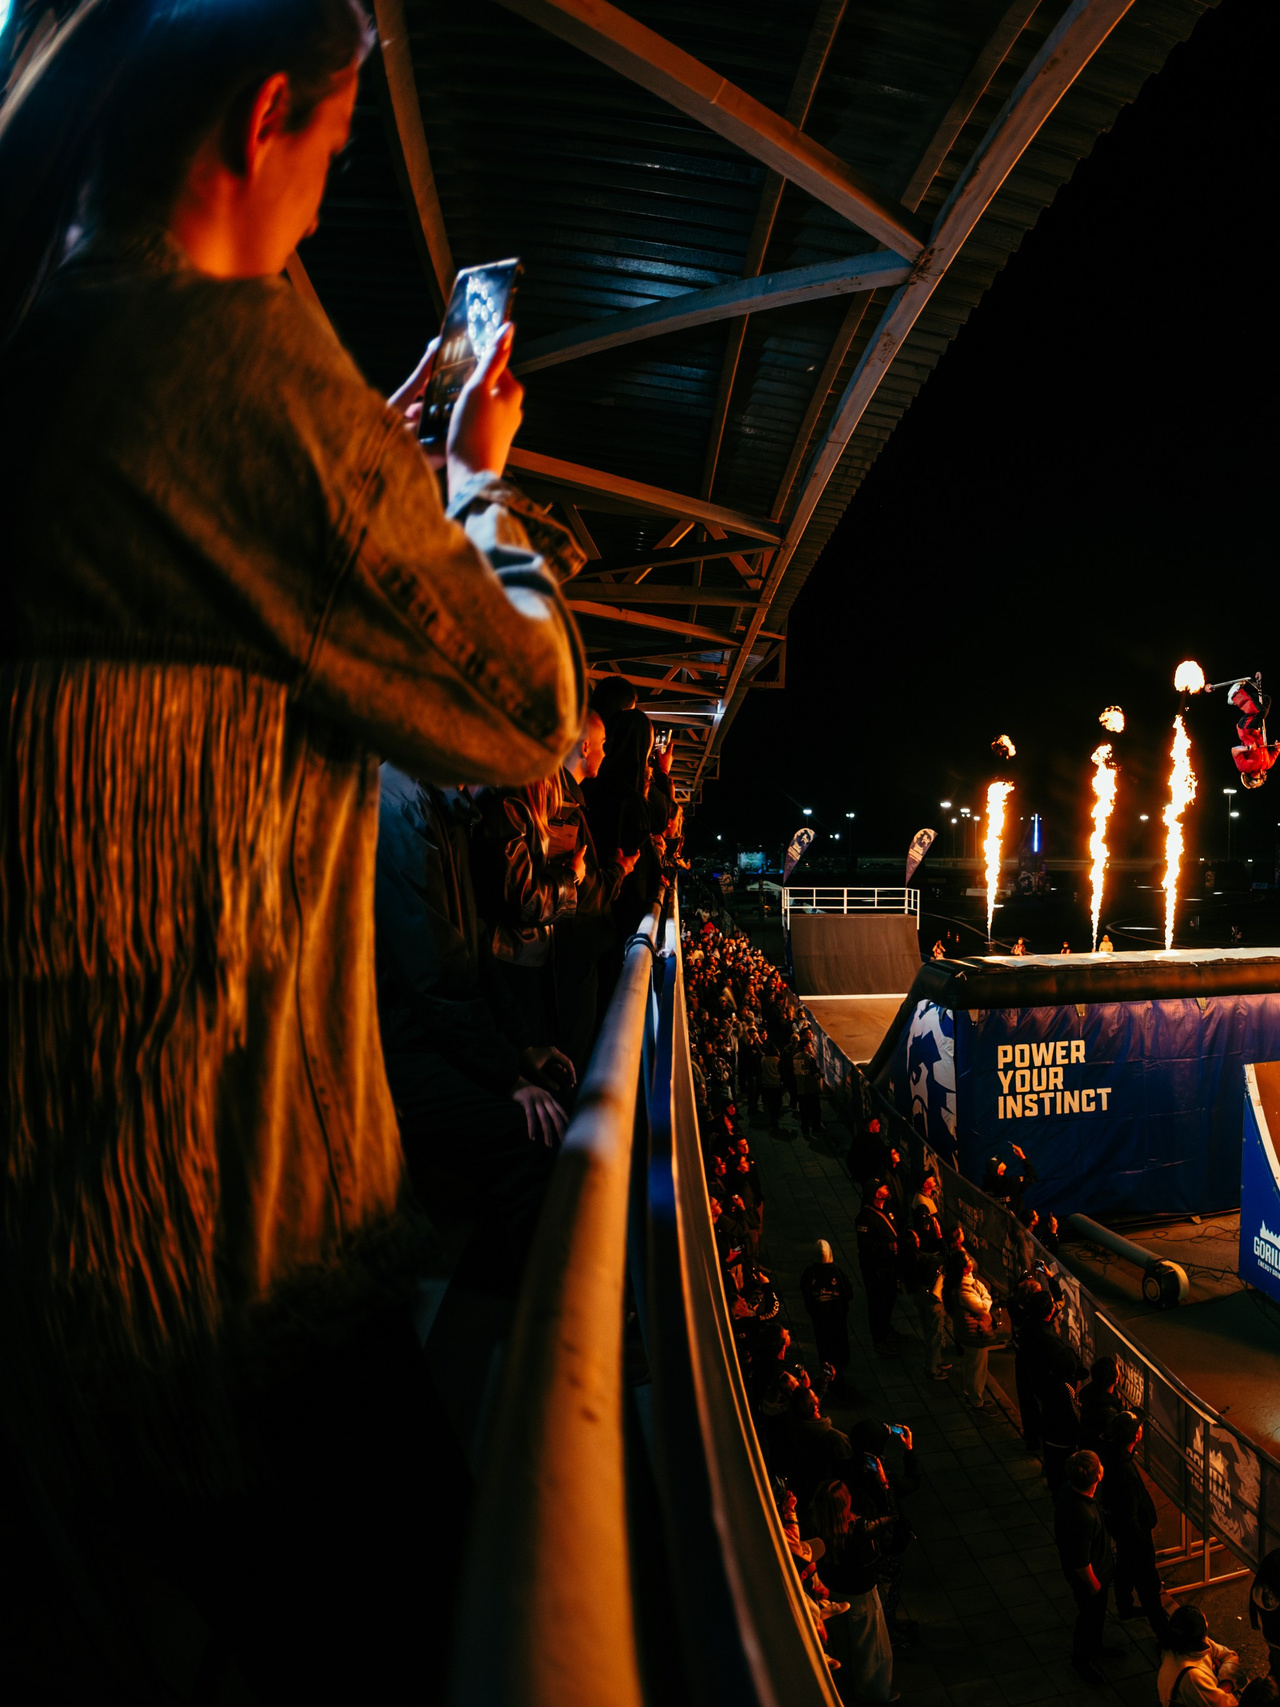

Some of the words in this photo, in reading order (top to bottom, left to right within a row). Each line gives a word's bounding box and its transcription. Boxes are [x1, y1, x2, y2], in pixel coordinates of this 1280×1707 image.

[997, 1040, 1086, 1070] POWER
[997, 1066, 1064, 1094] YOUR
[998, 1087, 1113, 1120] INSTINCT
